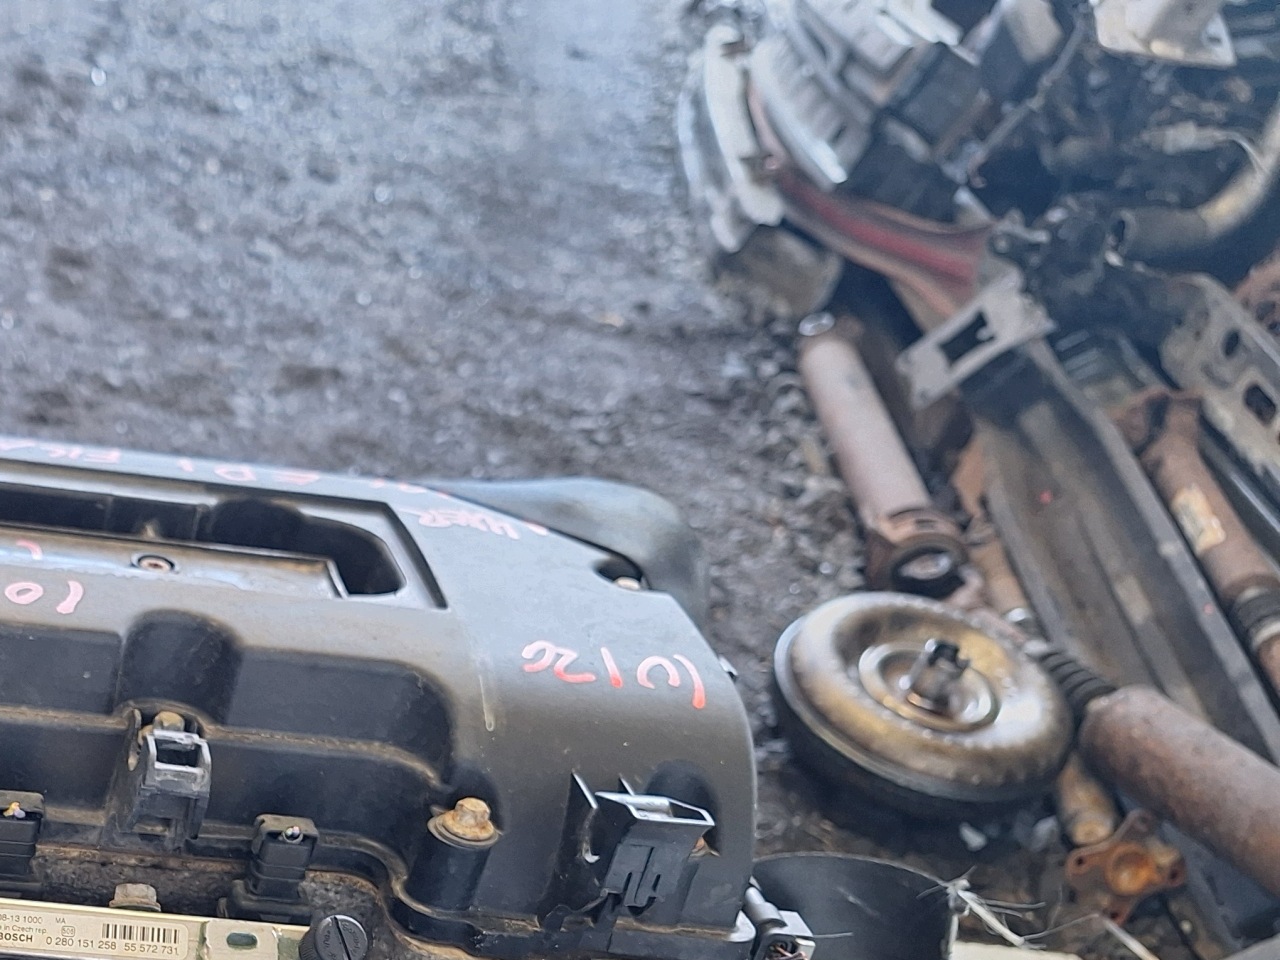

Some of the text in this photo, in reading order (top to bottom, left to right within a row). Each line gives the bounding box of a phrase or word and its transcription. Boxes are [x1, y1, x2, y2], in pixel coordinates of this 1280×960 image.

[3, 923, 11, 931] in
[11, 925, 34, 933] Czech
[55, 937, 74, 947] 280
[77, 939, 94, 948] 151
[98, 940, 117, 950] 258
[124, 943, 137, 952] 55
[139, 944, 158, 953] 572
[161, 945, 180, 956] 731
